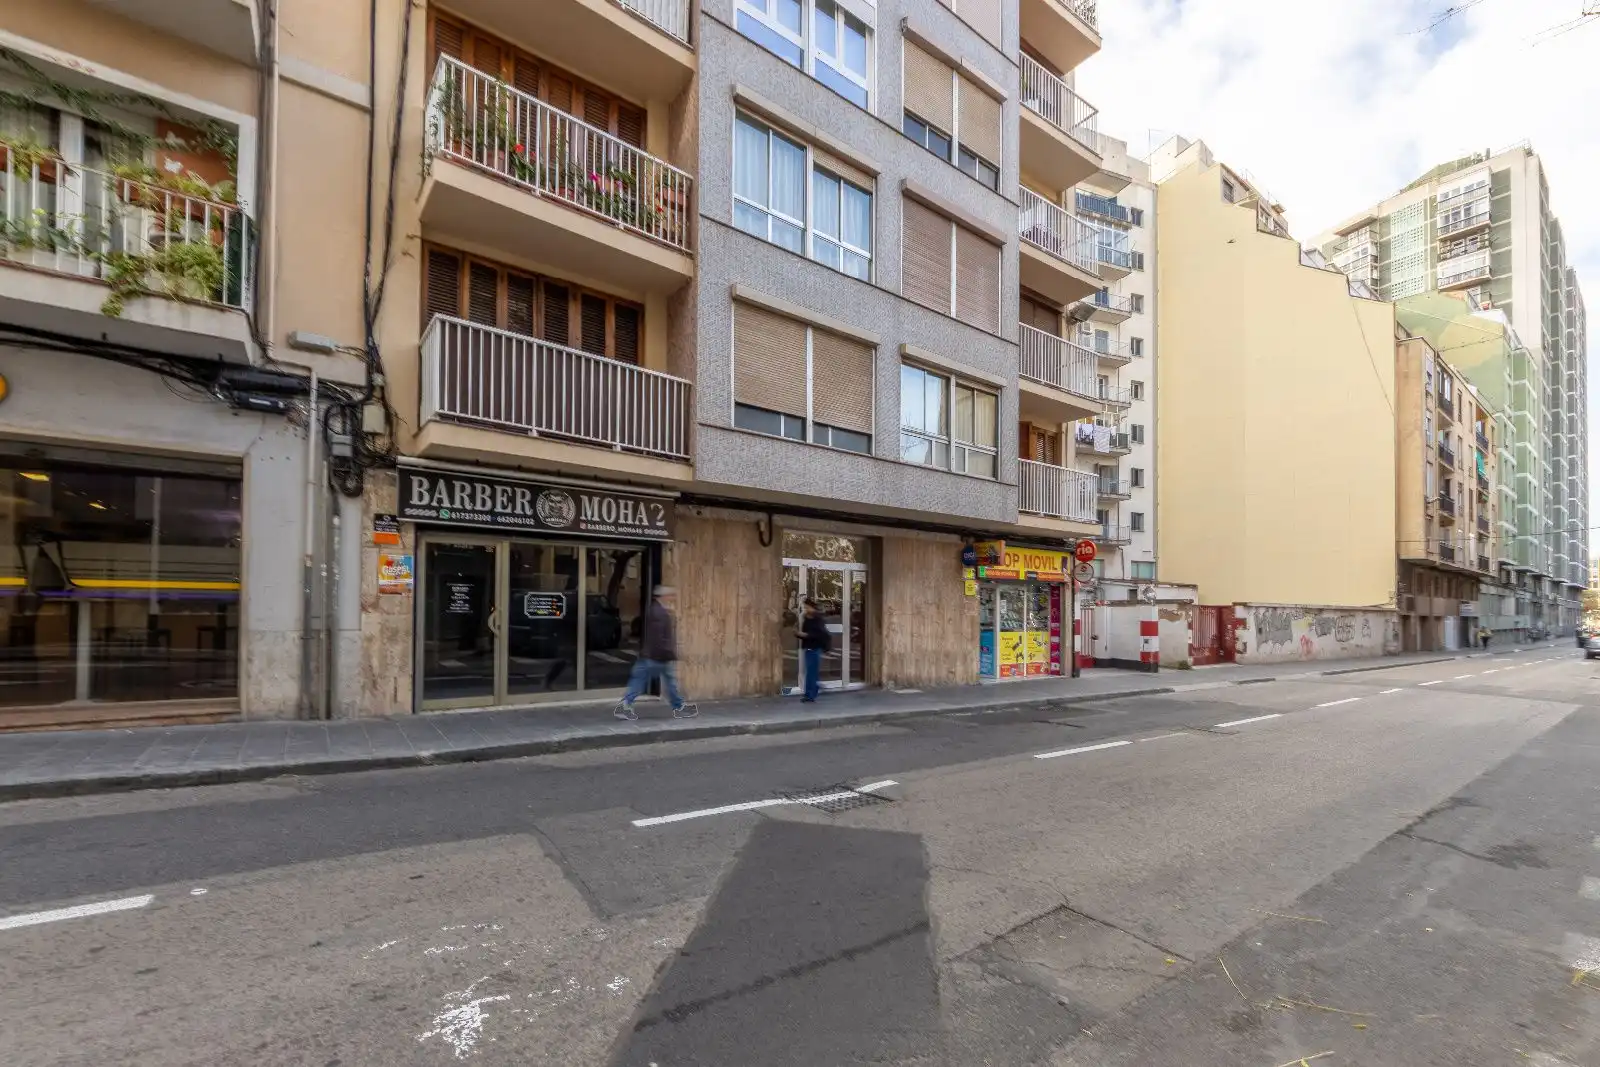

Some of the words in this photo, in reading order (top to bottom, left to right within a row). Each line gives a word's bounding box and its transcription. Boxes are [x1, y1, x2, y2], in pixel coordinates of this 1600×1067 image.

[409, 474, 534, 516] BARBER
[580, 494, 650, 527] MOHA
[650, 502, 665, 527] 2
[1077, 543, 1093, 555] ria
[1024, 553, 1058, 571] MOVIL
